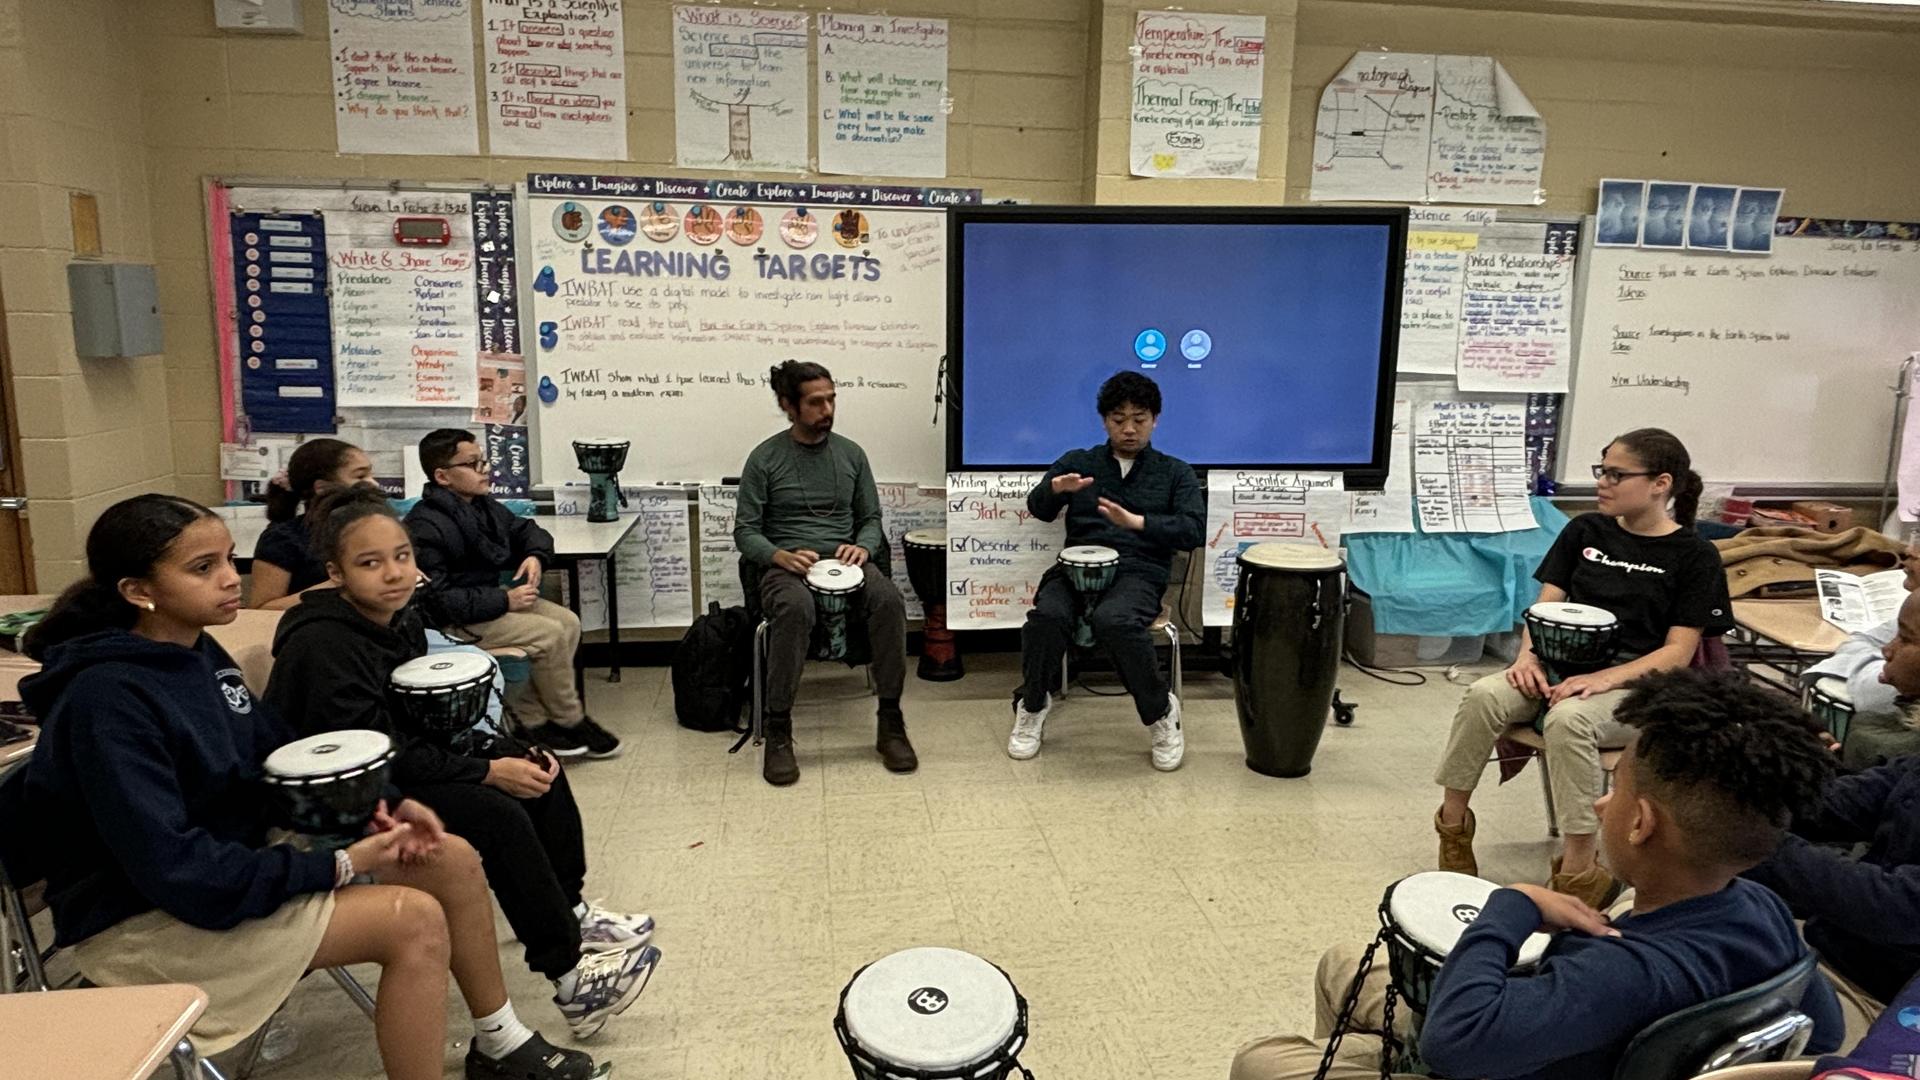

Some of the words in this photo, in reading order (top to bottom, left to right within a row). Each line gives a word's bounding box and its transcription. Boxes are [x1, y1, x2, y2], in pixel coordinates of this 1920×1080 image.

[523, 7, 596, 23] Explanation?
[679, 26, 728, 42] Science
[820, 14, 865, 39] Planning
[838, 71, 862, 84] What
[1136, 83, 1183, 106] Thermal
[838, 108, 860, 120] What
[534, 175, 574, 192] Explore
[591, 176, 638, 195] Imagine
[655, 181, 698, 195] Discover
[716, 182, 750, 198] Create
[757, 183, 794, 199] Explore
[811, 184, 855, 203] Imagine
[872, 189, 912, 203] Discover
[929, 192, 962, 205] Create
[474, 201, 491, 238] Explore
[494, 201, 511, 239] Explore
[1409, 208, 1451, 222] Science
[339, 251, 377, 267] Write
[380, 252, 393, 266] &
[400, 252, 432, 267] Share
[581, 248, 731, 281] LEARNING
[753, 252, 882, 282] TARGETS
[1470, 255, 1496, 268] Word
[1500, 254, 1562, 271] Relationships
[337, 271, 392, 285] Predators
[414, 275, 465, 289] Consumers
[477, 257, 494, 290] Imagi
[560, 279, 617, 298] IWBAT
[622, 285, 643, 296] use
[560, 315, 612, 332] IWBAT
[501, 319, 516, 353] Discove
[560, 368, 603, 385] IWBAT
[488, 435, 506, 466] Create
[509, 444, 525, 477] Create
[949, 473, 987, 496] Writing
[1236, 471, 1288, 488] Scientific
[1292, 472, 1337, 493] Argument
[970, 501, 1006, 521] State
[971, 537, 1019, 553] Describe
[1030, 538, 1050, 552] the
[970, 555, 1012, 566] evidence
[1583, 547, 1666, 574] Champion
[970, 580, 1015, 597] Explain
[970, 596, 1010, 607] evidence
